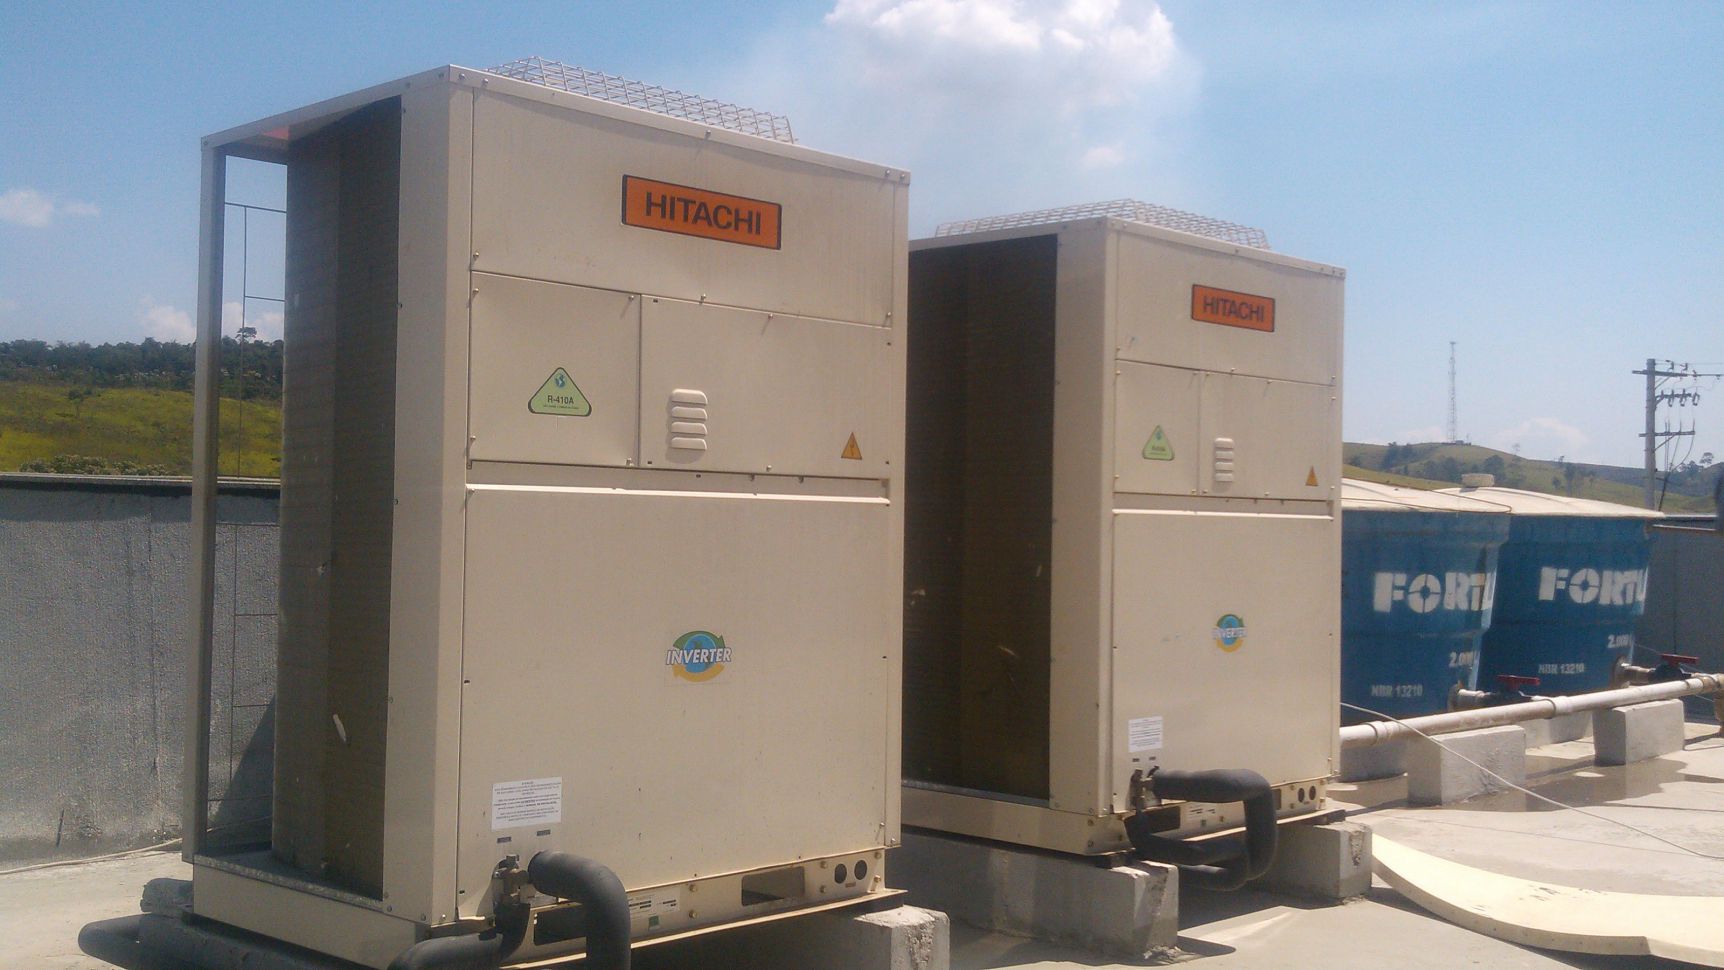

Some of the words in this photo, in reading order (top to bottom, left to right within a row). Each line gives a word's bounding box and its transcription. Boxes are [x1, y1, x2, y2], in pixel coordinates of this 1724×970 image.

[646, 192, 761, 235] HITACHI
[1203, 295, 1264, 322] HITACHI
[547, 395, 574, 404] R-410A
[666, 647, 732, 665] INVERTER
